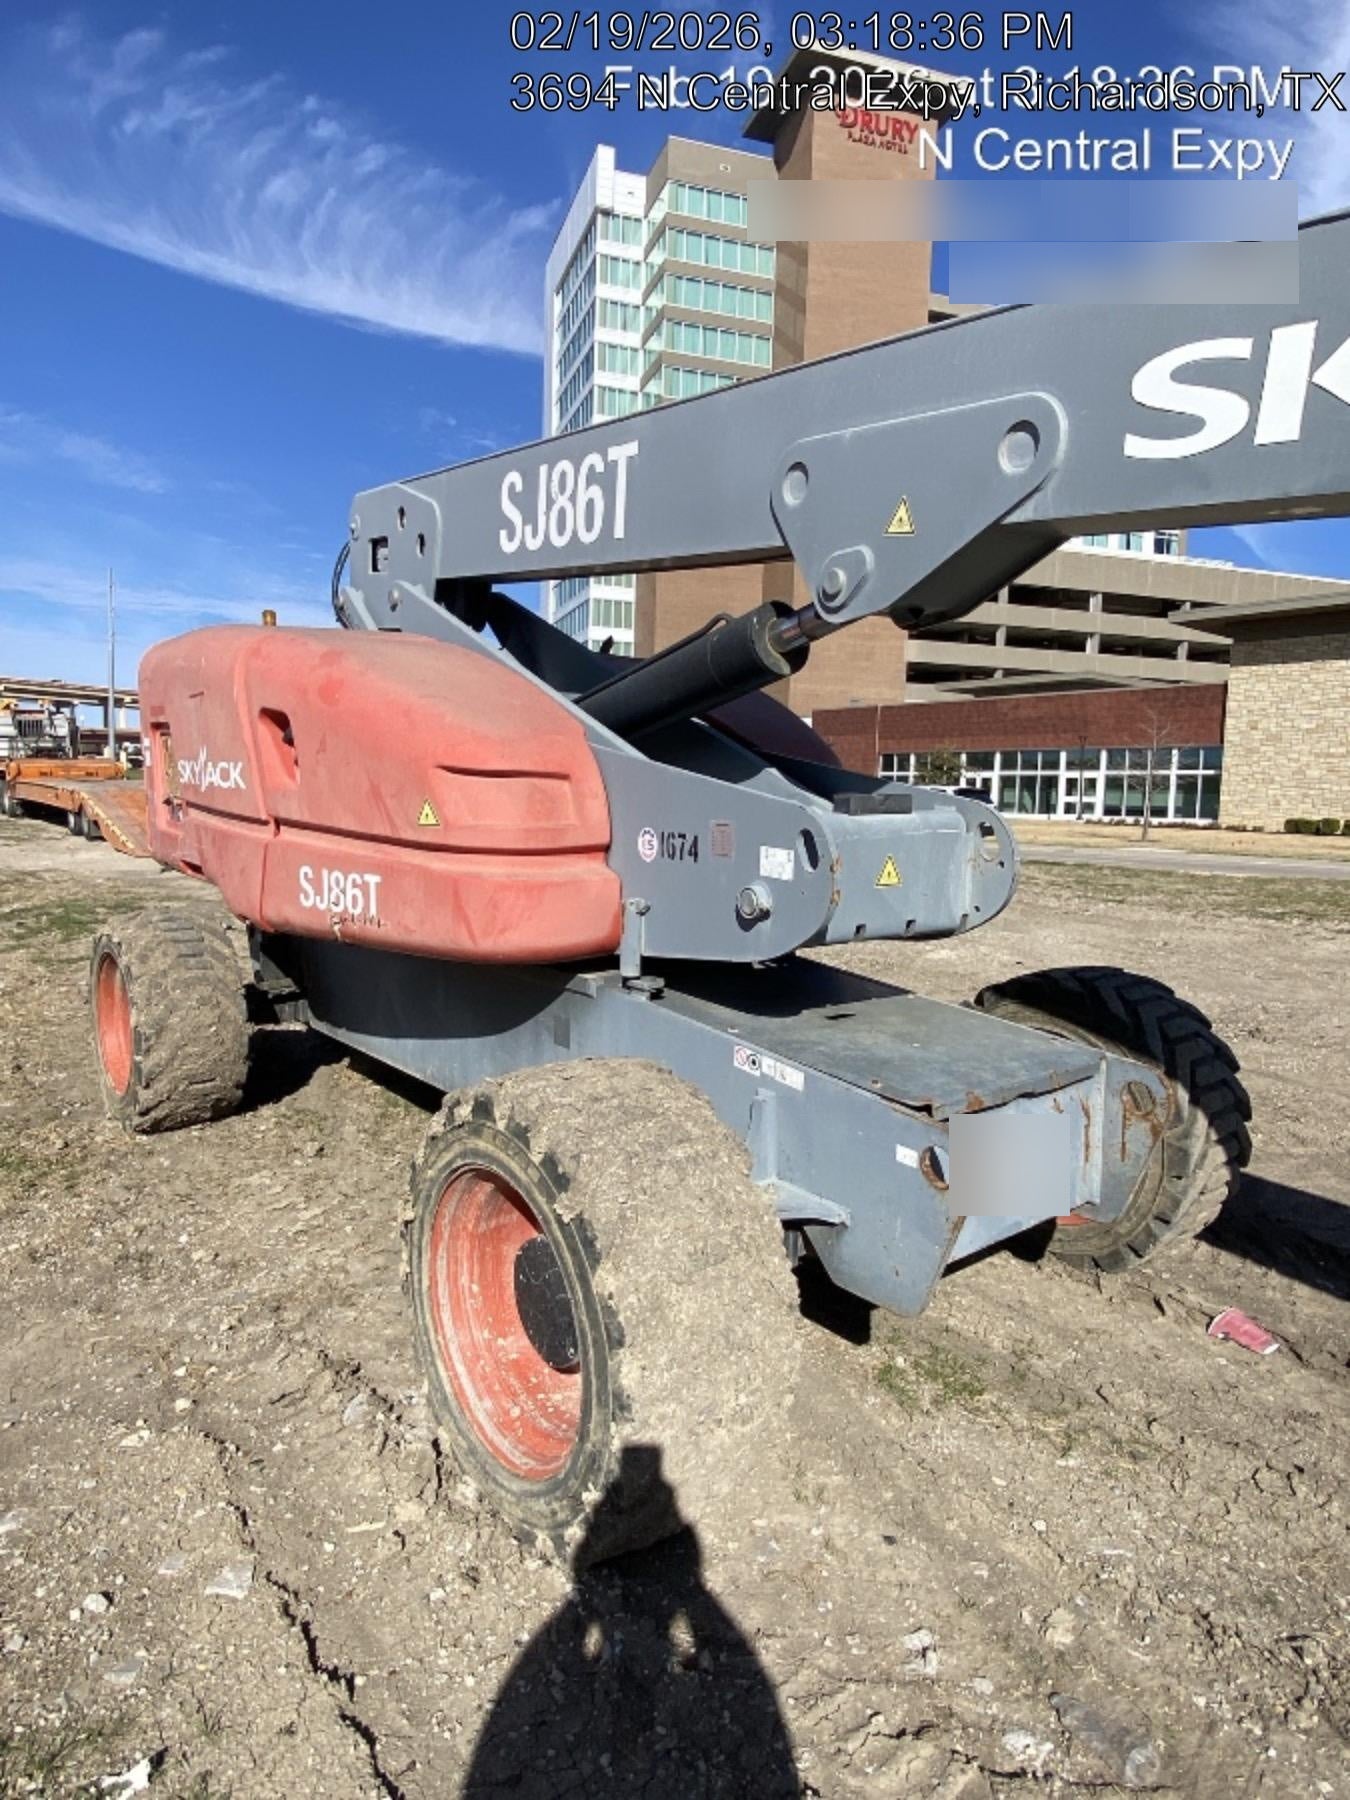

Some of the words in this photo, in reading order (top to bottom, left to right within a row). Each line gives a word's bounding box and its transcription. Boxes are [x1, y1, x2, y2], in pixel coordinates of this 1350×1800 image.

[834, 104, 919, 144] DRURY
[499, 440, 639, 553] SJ86T
[177, 744, 247, 793] SKYJACK
[660, 831, 699, 864] 1674
[299, 864, 382, 919] SJ86T
